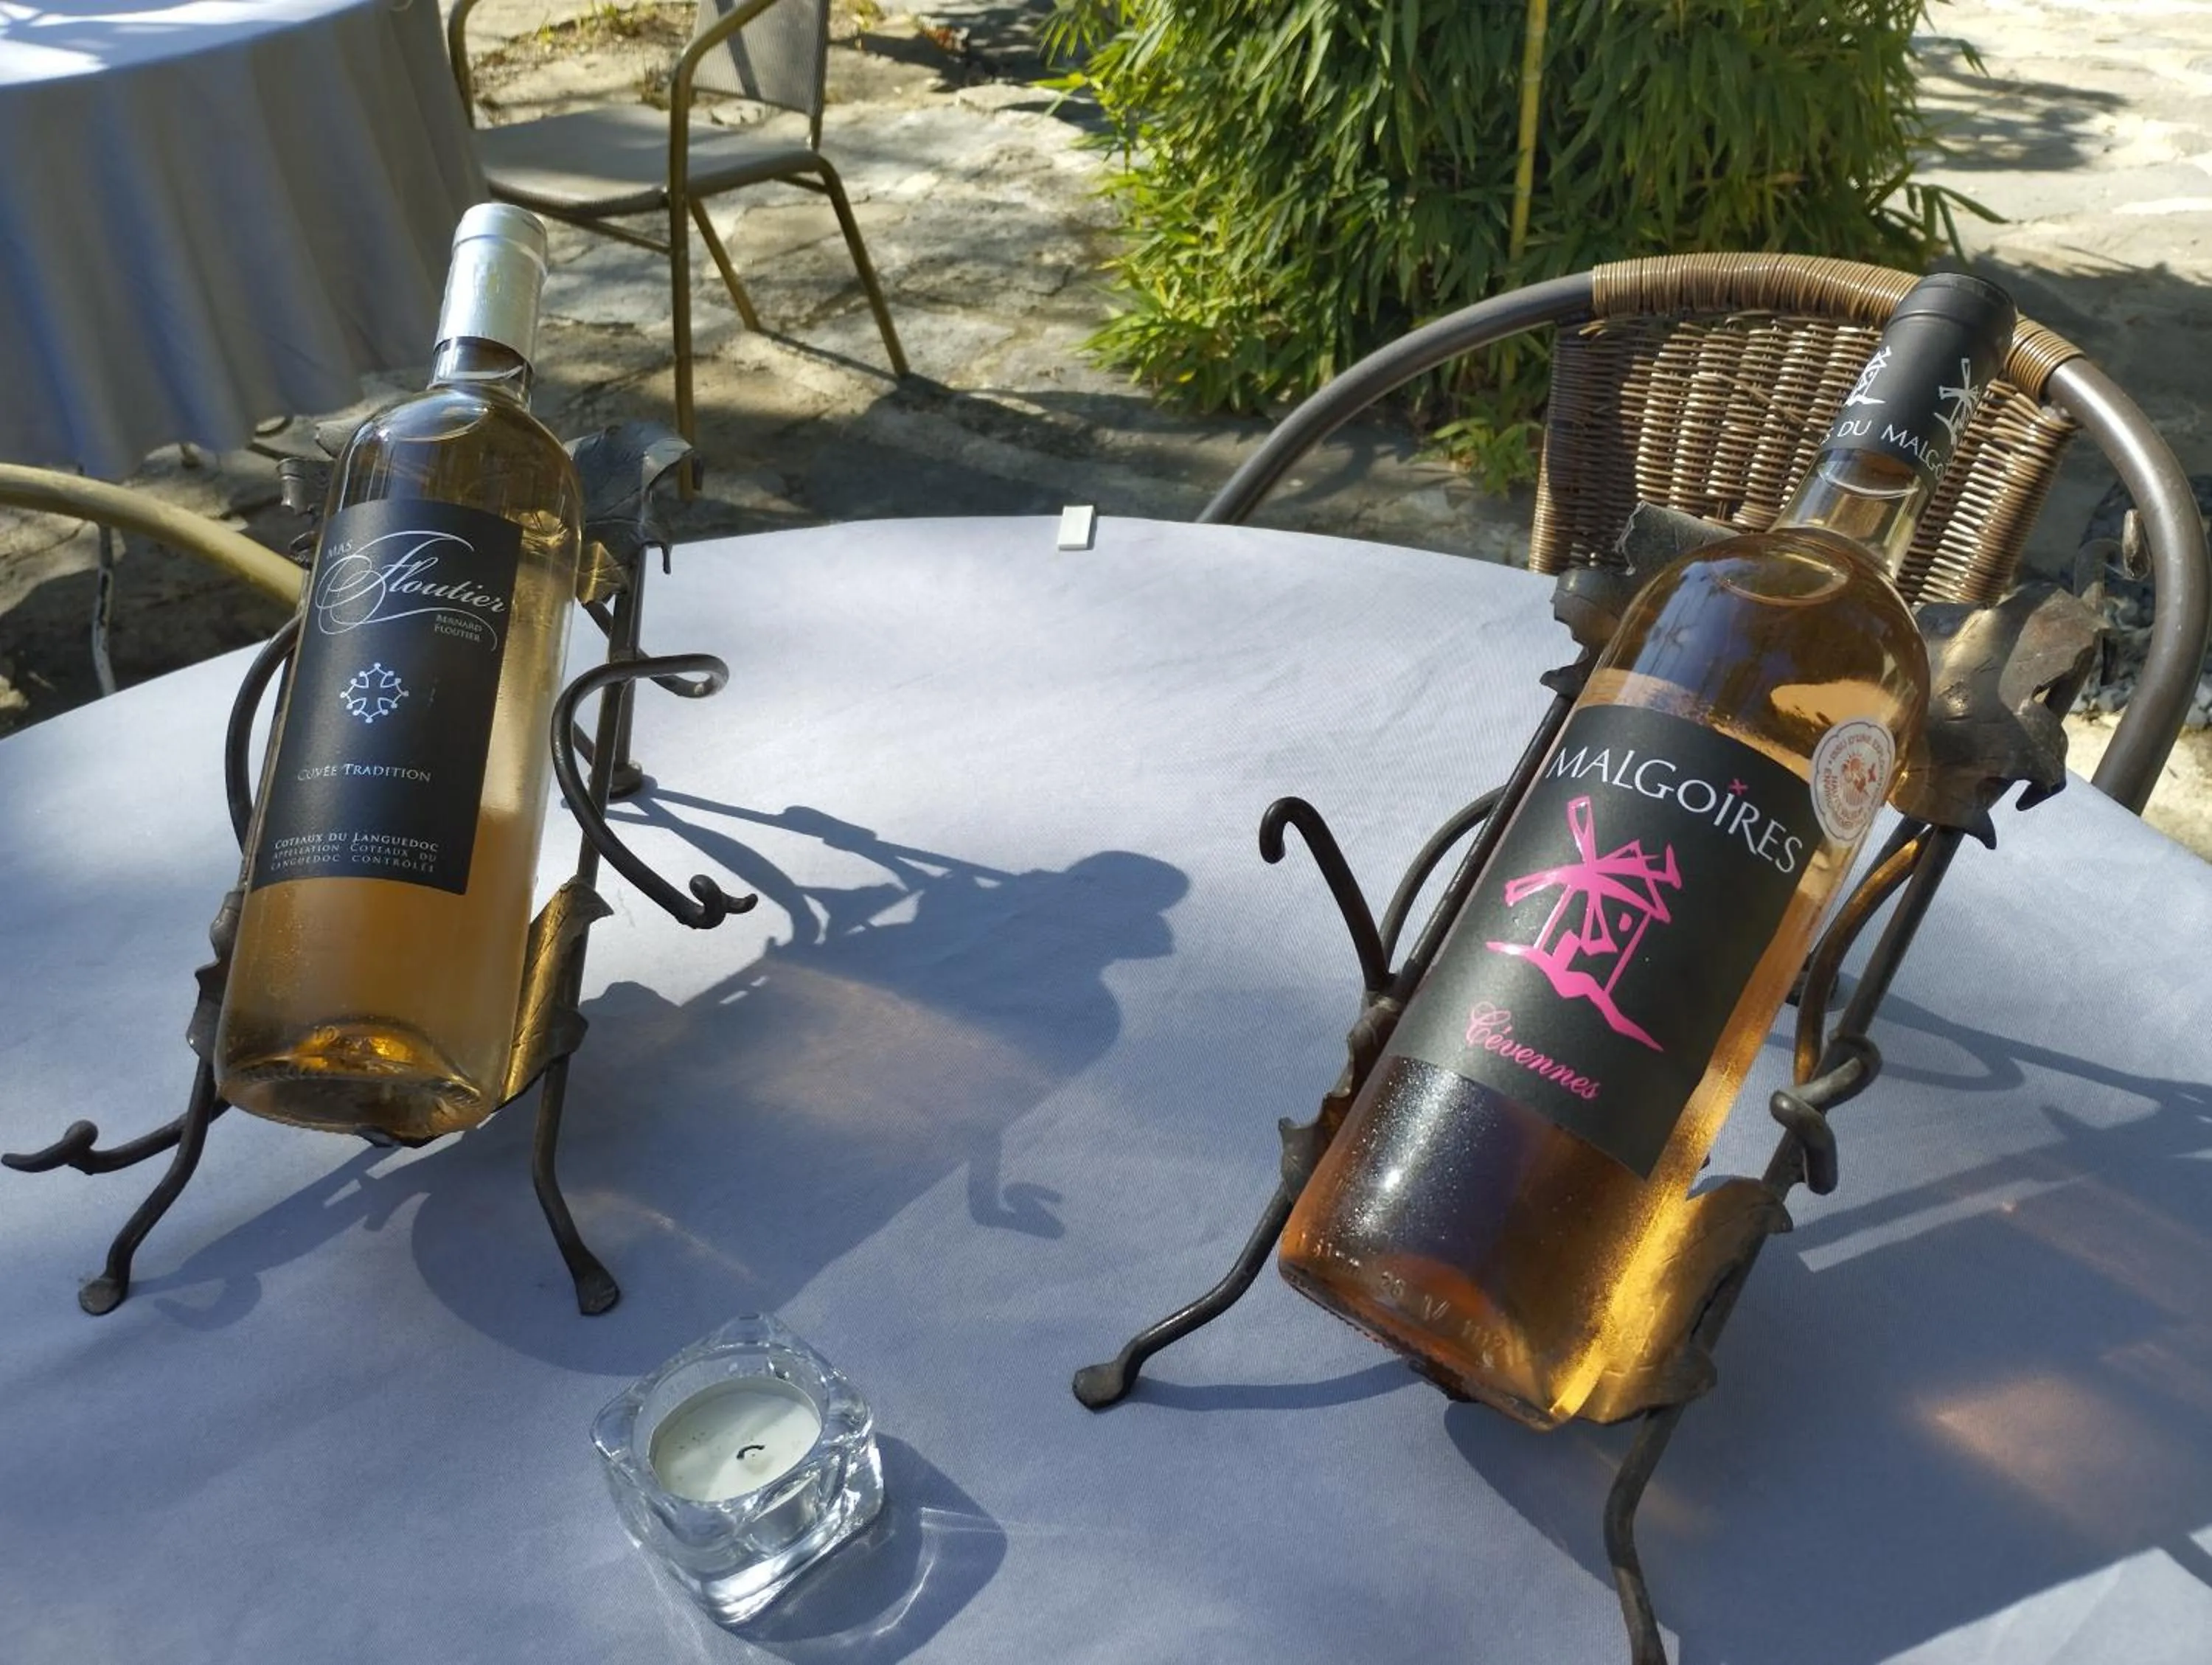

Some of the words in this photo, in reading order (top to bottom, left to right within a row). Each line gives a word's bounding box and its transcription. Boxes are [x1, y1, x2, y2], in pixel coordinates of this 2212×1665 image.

[1837, 420, 1872, 437] DU
[327, 539, 353, 559] MAS
[316, 530, 507, 636] Floutier
[436, 613, 483, 632] BERNARD
[434, 625, 481, 643] FLOUTIER
[328, 832, 347, 842] DU
[419, 852, 437, 862] DU
[1465, 1001, 1601, 1101] Cévennes
